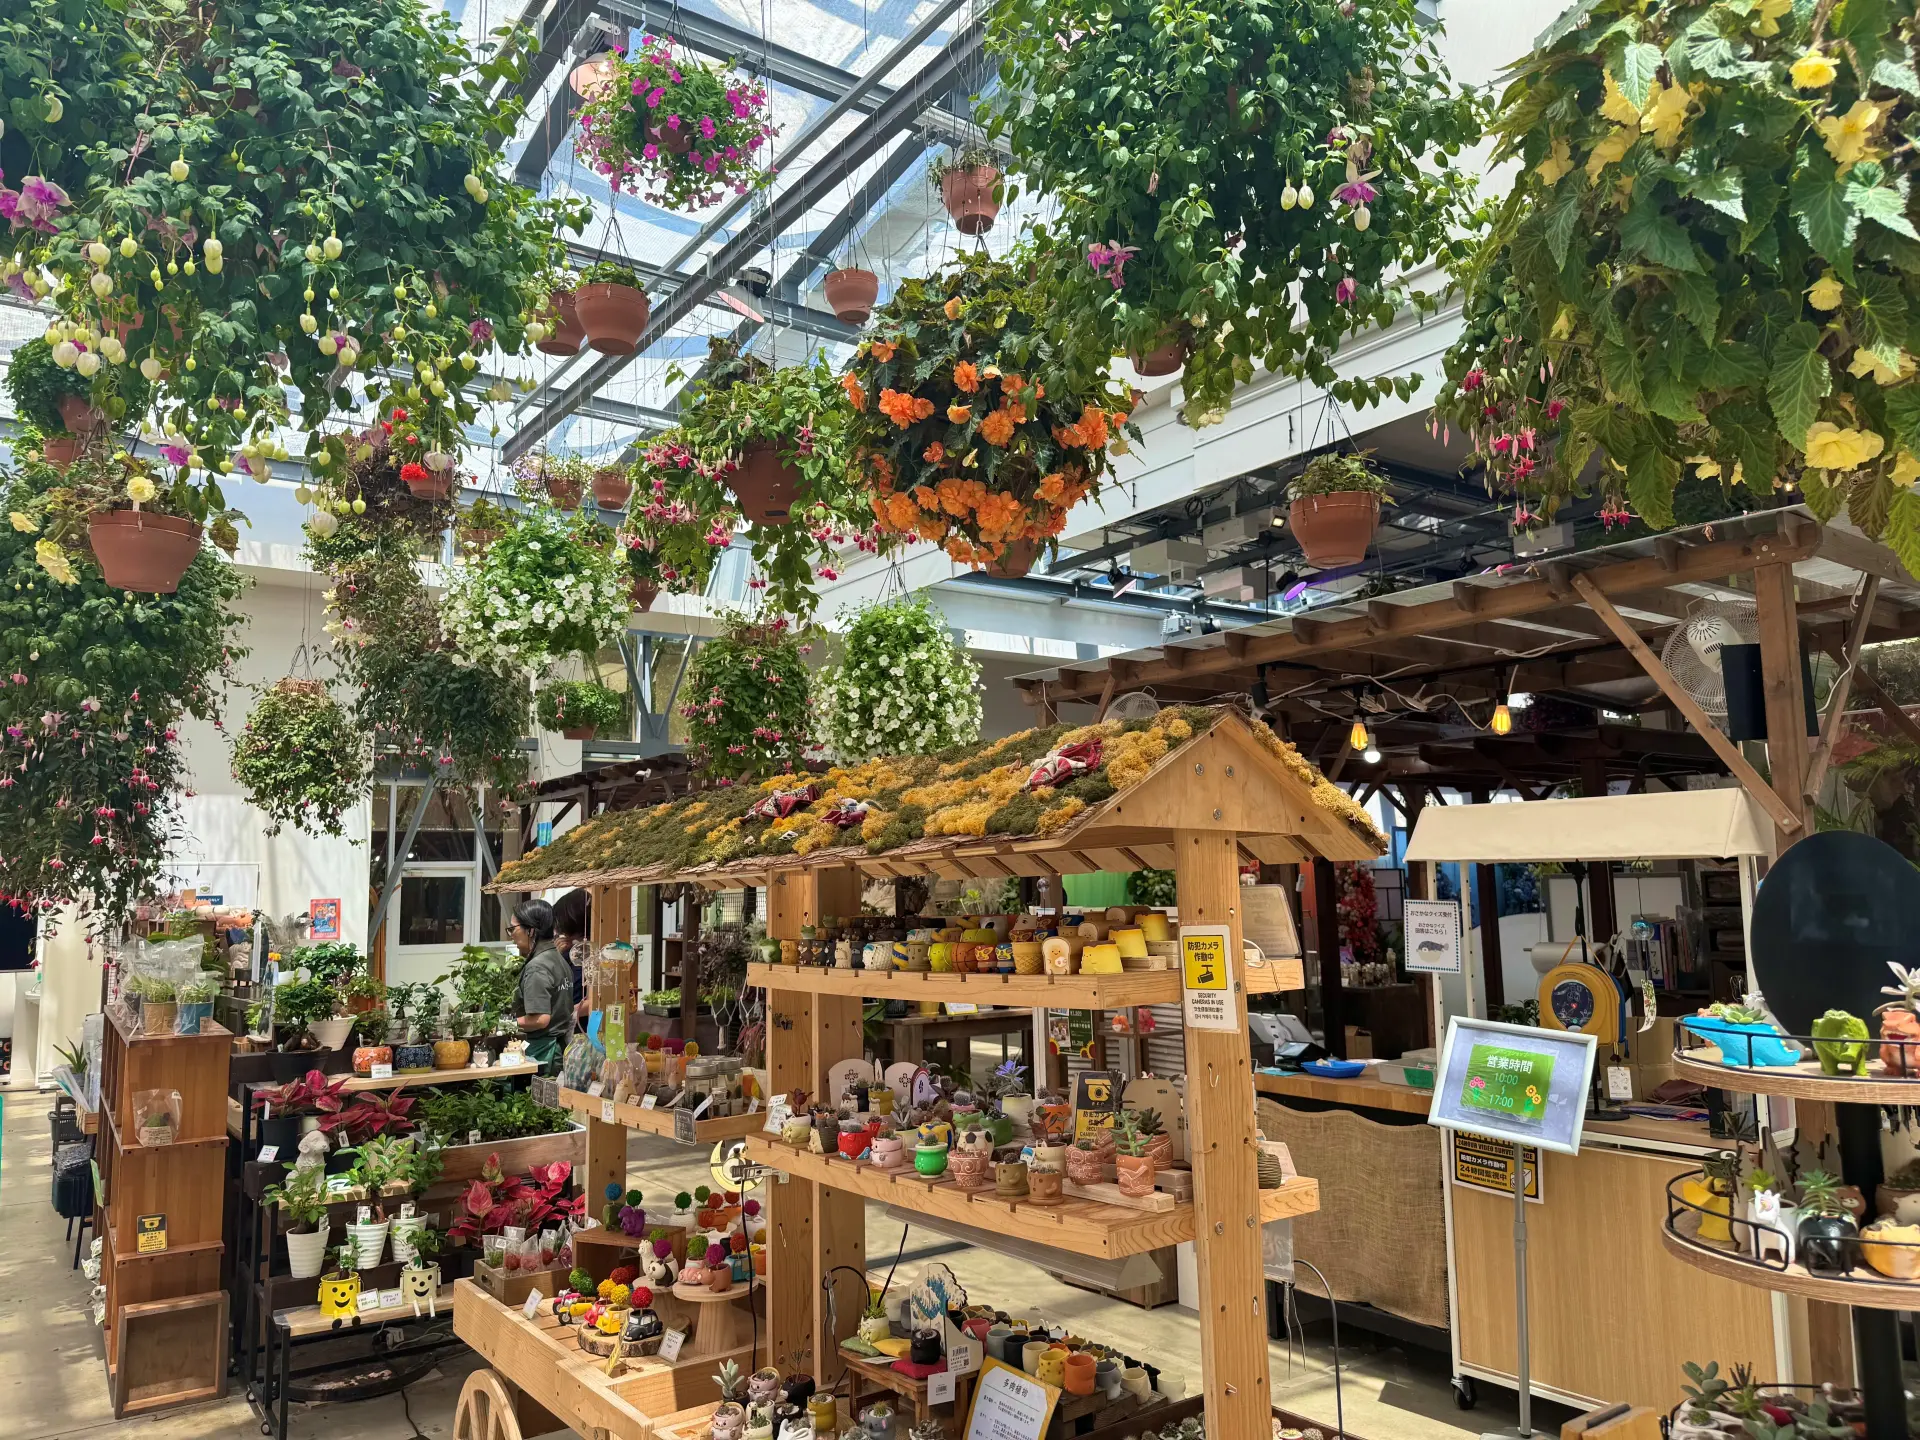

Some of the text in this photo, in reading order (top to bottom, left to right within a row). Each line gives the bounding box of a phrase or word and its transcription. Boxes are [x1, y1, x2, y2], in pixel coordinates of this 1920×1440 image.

[1410, 910, 1452, 918] おさかなクイズ受付
[1187, 941, 1219, 951] 防犯カメラ
[1194, 952, 1214, 962] 作動中
[1486, 1054, 1534, 1074] 営業時間
[1495, 1072, 1518, 1085] 10:00
[1489, 1094, 1514, 1108] 17:00
[1458, 1139, 1533, 1160] 24HOUR VIDEO SURVEINCE
[1460, 1154, 1506, 1169] 防犯カメラ作動中
[1460, 1164, 1507, 1181] 24時間監視中
[1003, 1378, 1029, 1398] 多肉植物
